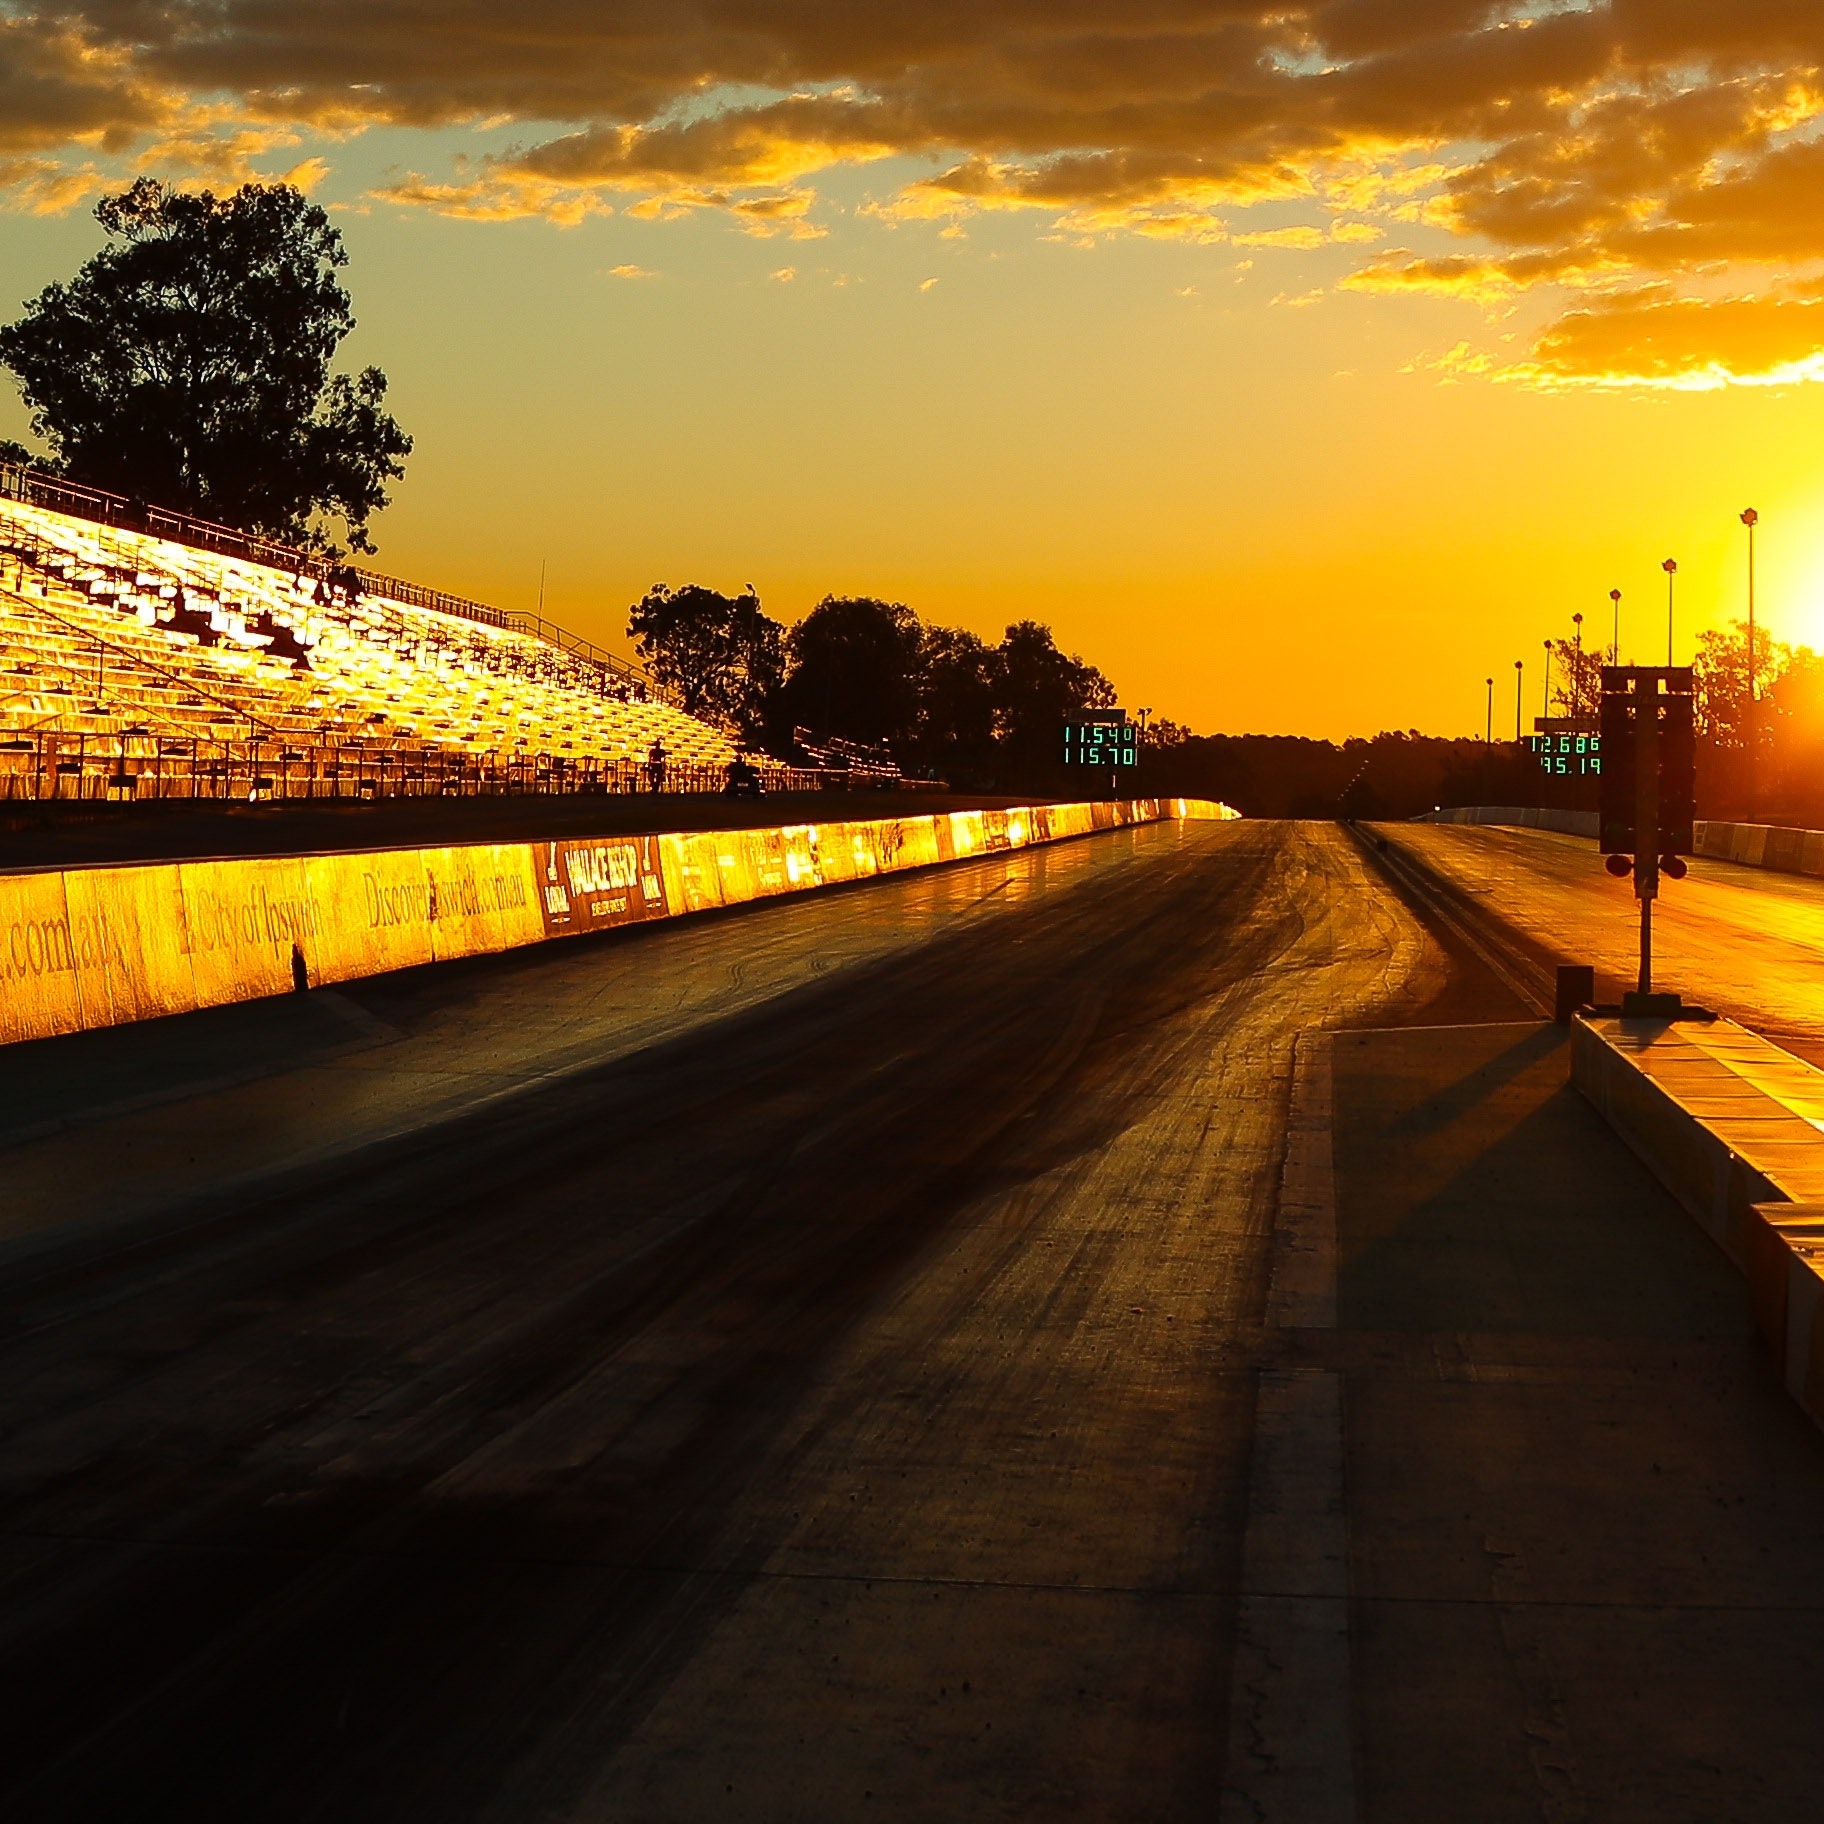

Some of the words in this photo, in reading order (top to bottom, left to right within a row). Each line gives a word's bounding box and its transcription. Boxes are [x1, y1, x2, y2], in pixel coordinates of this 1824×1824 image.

[1065, 726, 1132, 744] 11.540
[1532, 736, 1599, 754] 12.686
[1065, 747, 1133, 765] 115.70
